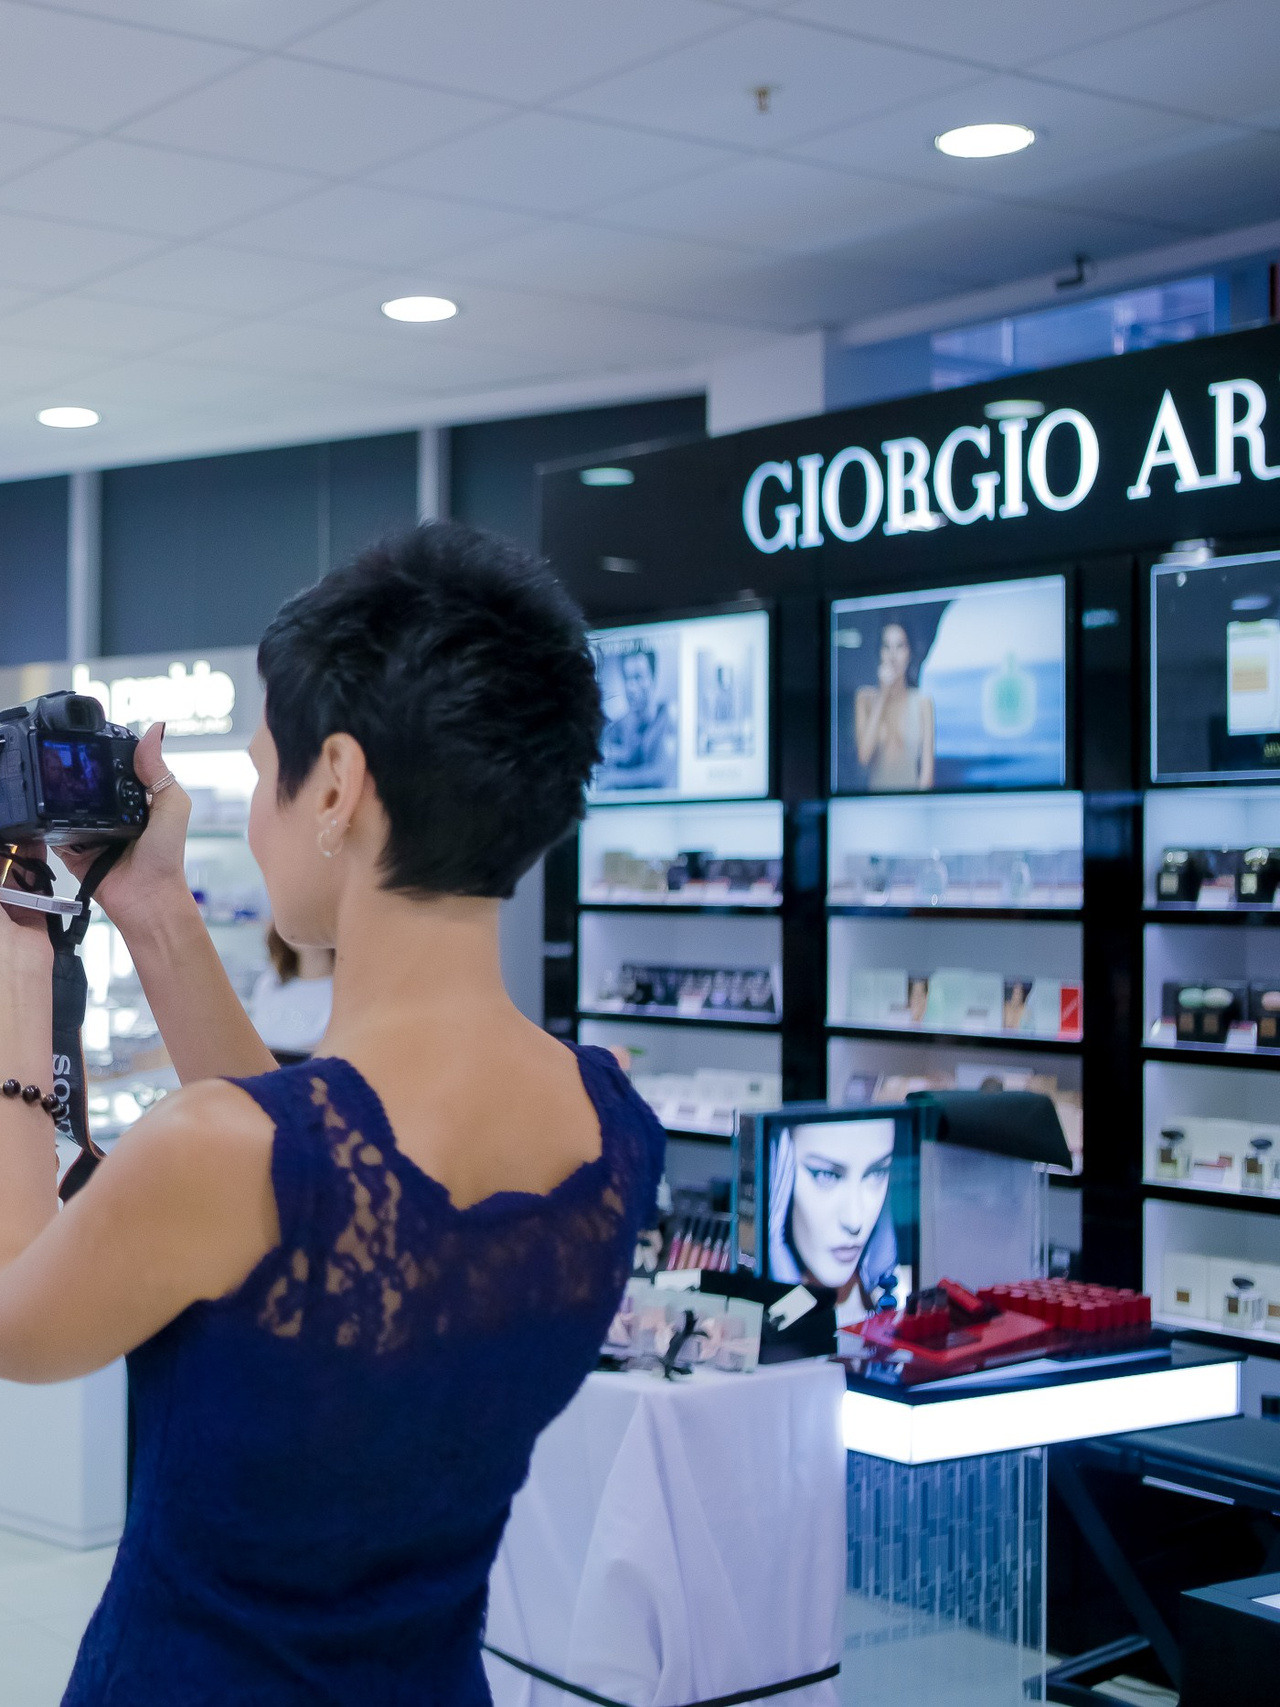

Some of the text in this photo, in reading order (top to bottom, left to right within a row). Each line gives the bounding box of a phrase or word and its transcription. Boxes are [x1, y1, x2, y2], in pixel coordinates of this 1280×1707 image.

[742, 378, 1280, 554] GIORGIO AR
[52, 1053, 78, 1145] SO
